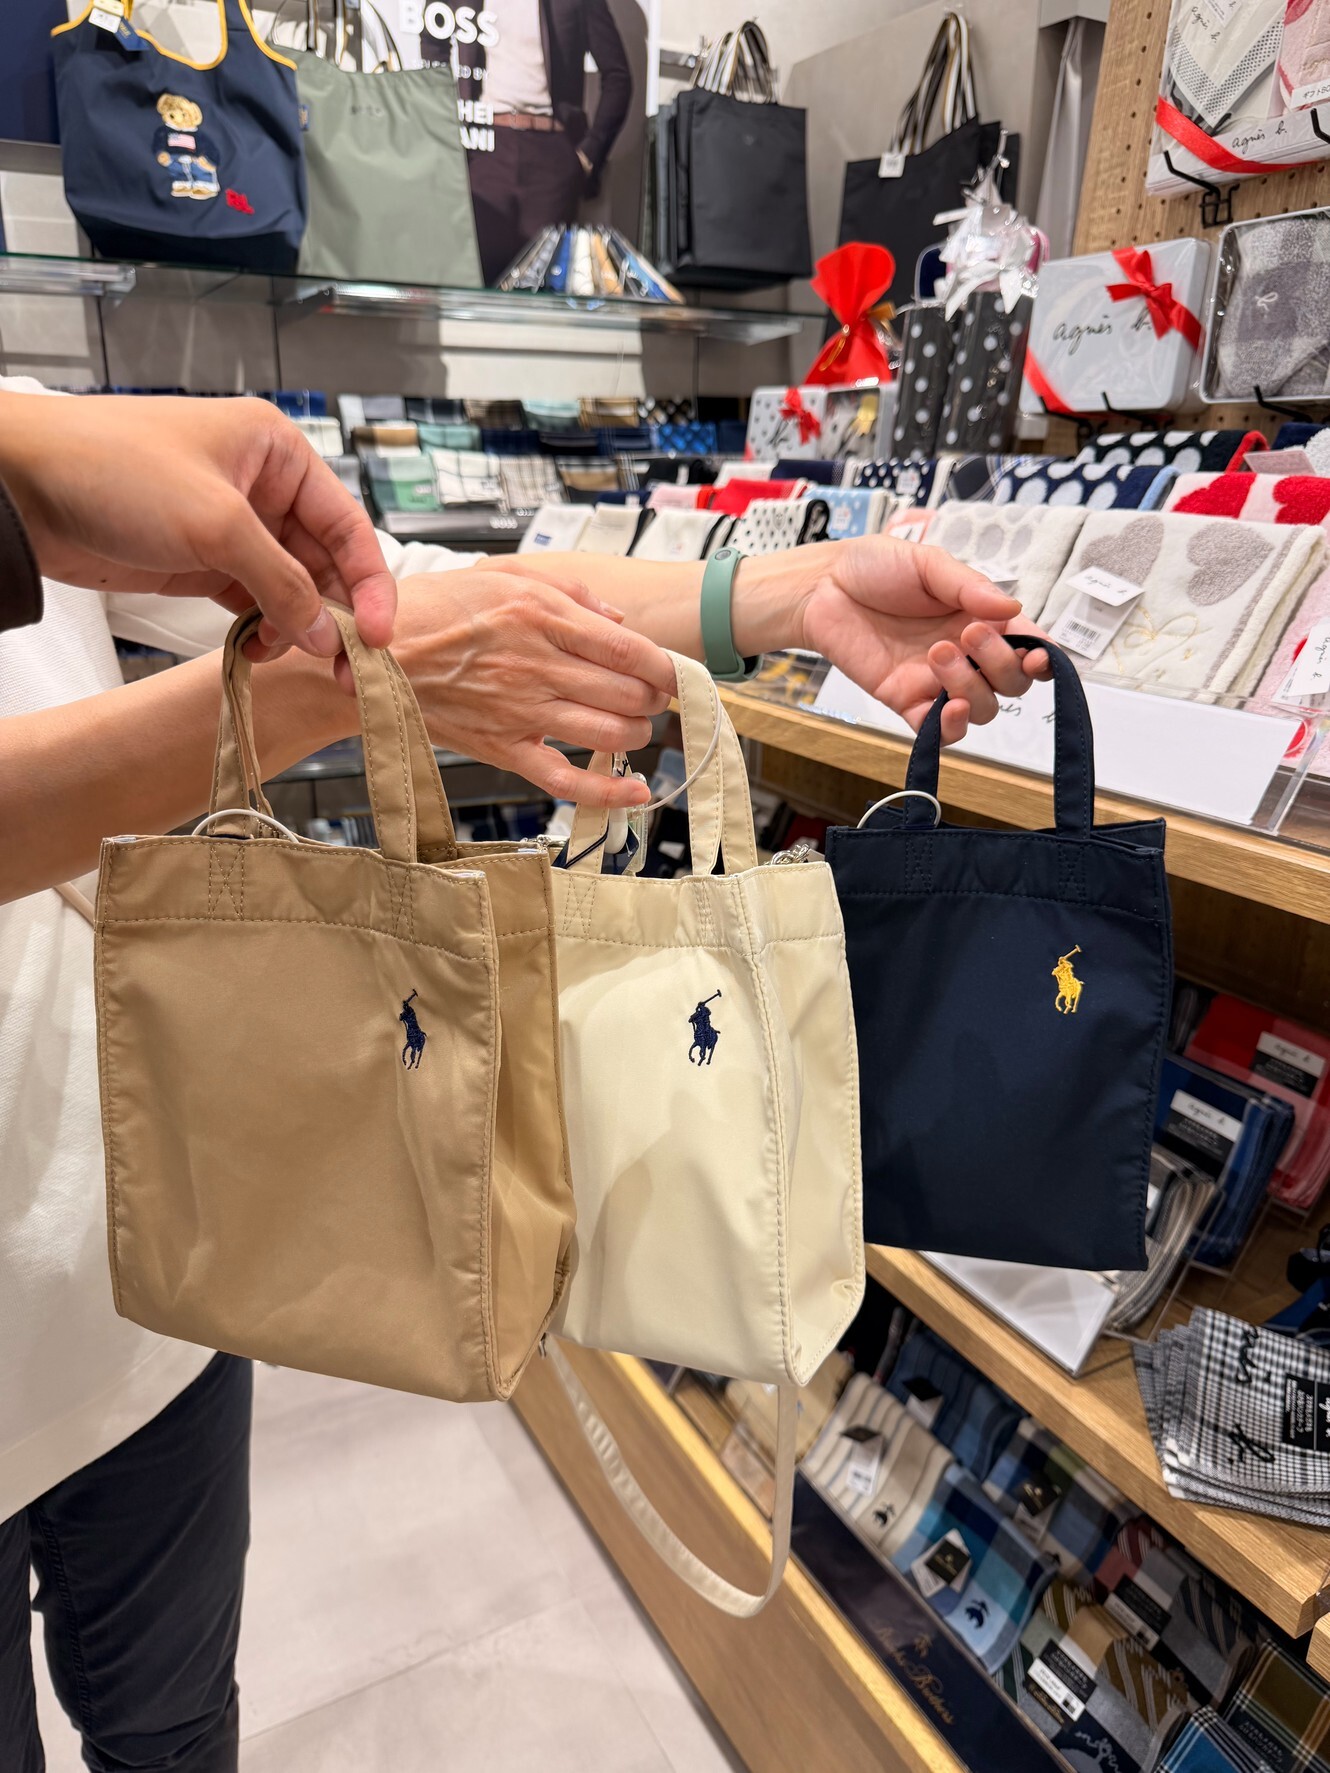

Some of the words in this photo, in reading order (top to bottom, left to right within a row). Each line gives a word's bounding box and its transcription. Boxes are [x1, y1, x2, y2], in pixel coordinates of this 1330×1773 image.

[398, 1, 499, 47] BOSS
[1231, 129, 1266, 155] agnès
[1275, 120, 1288, 135] b.
[1052, 314, 1113, 357] agnès
